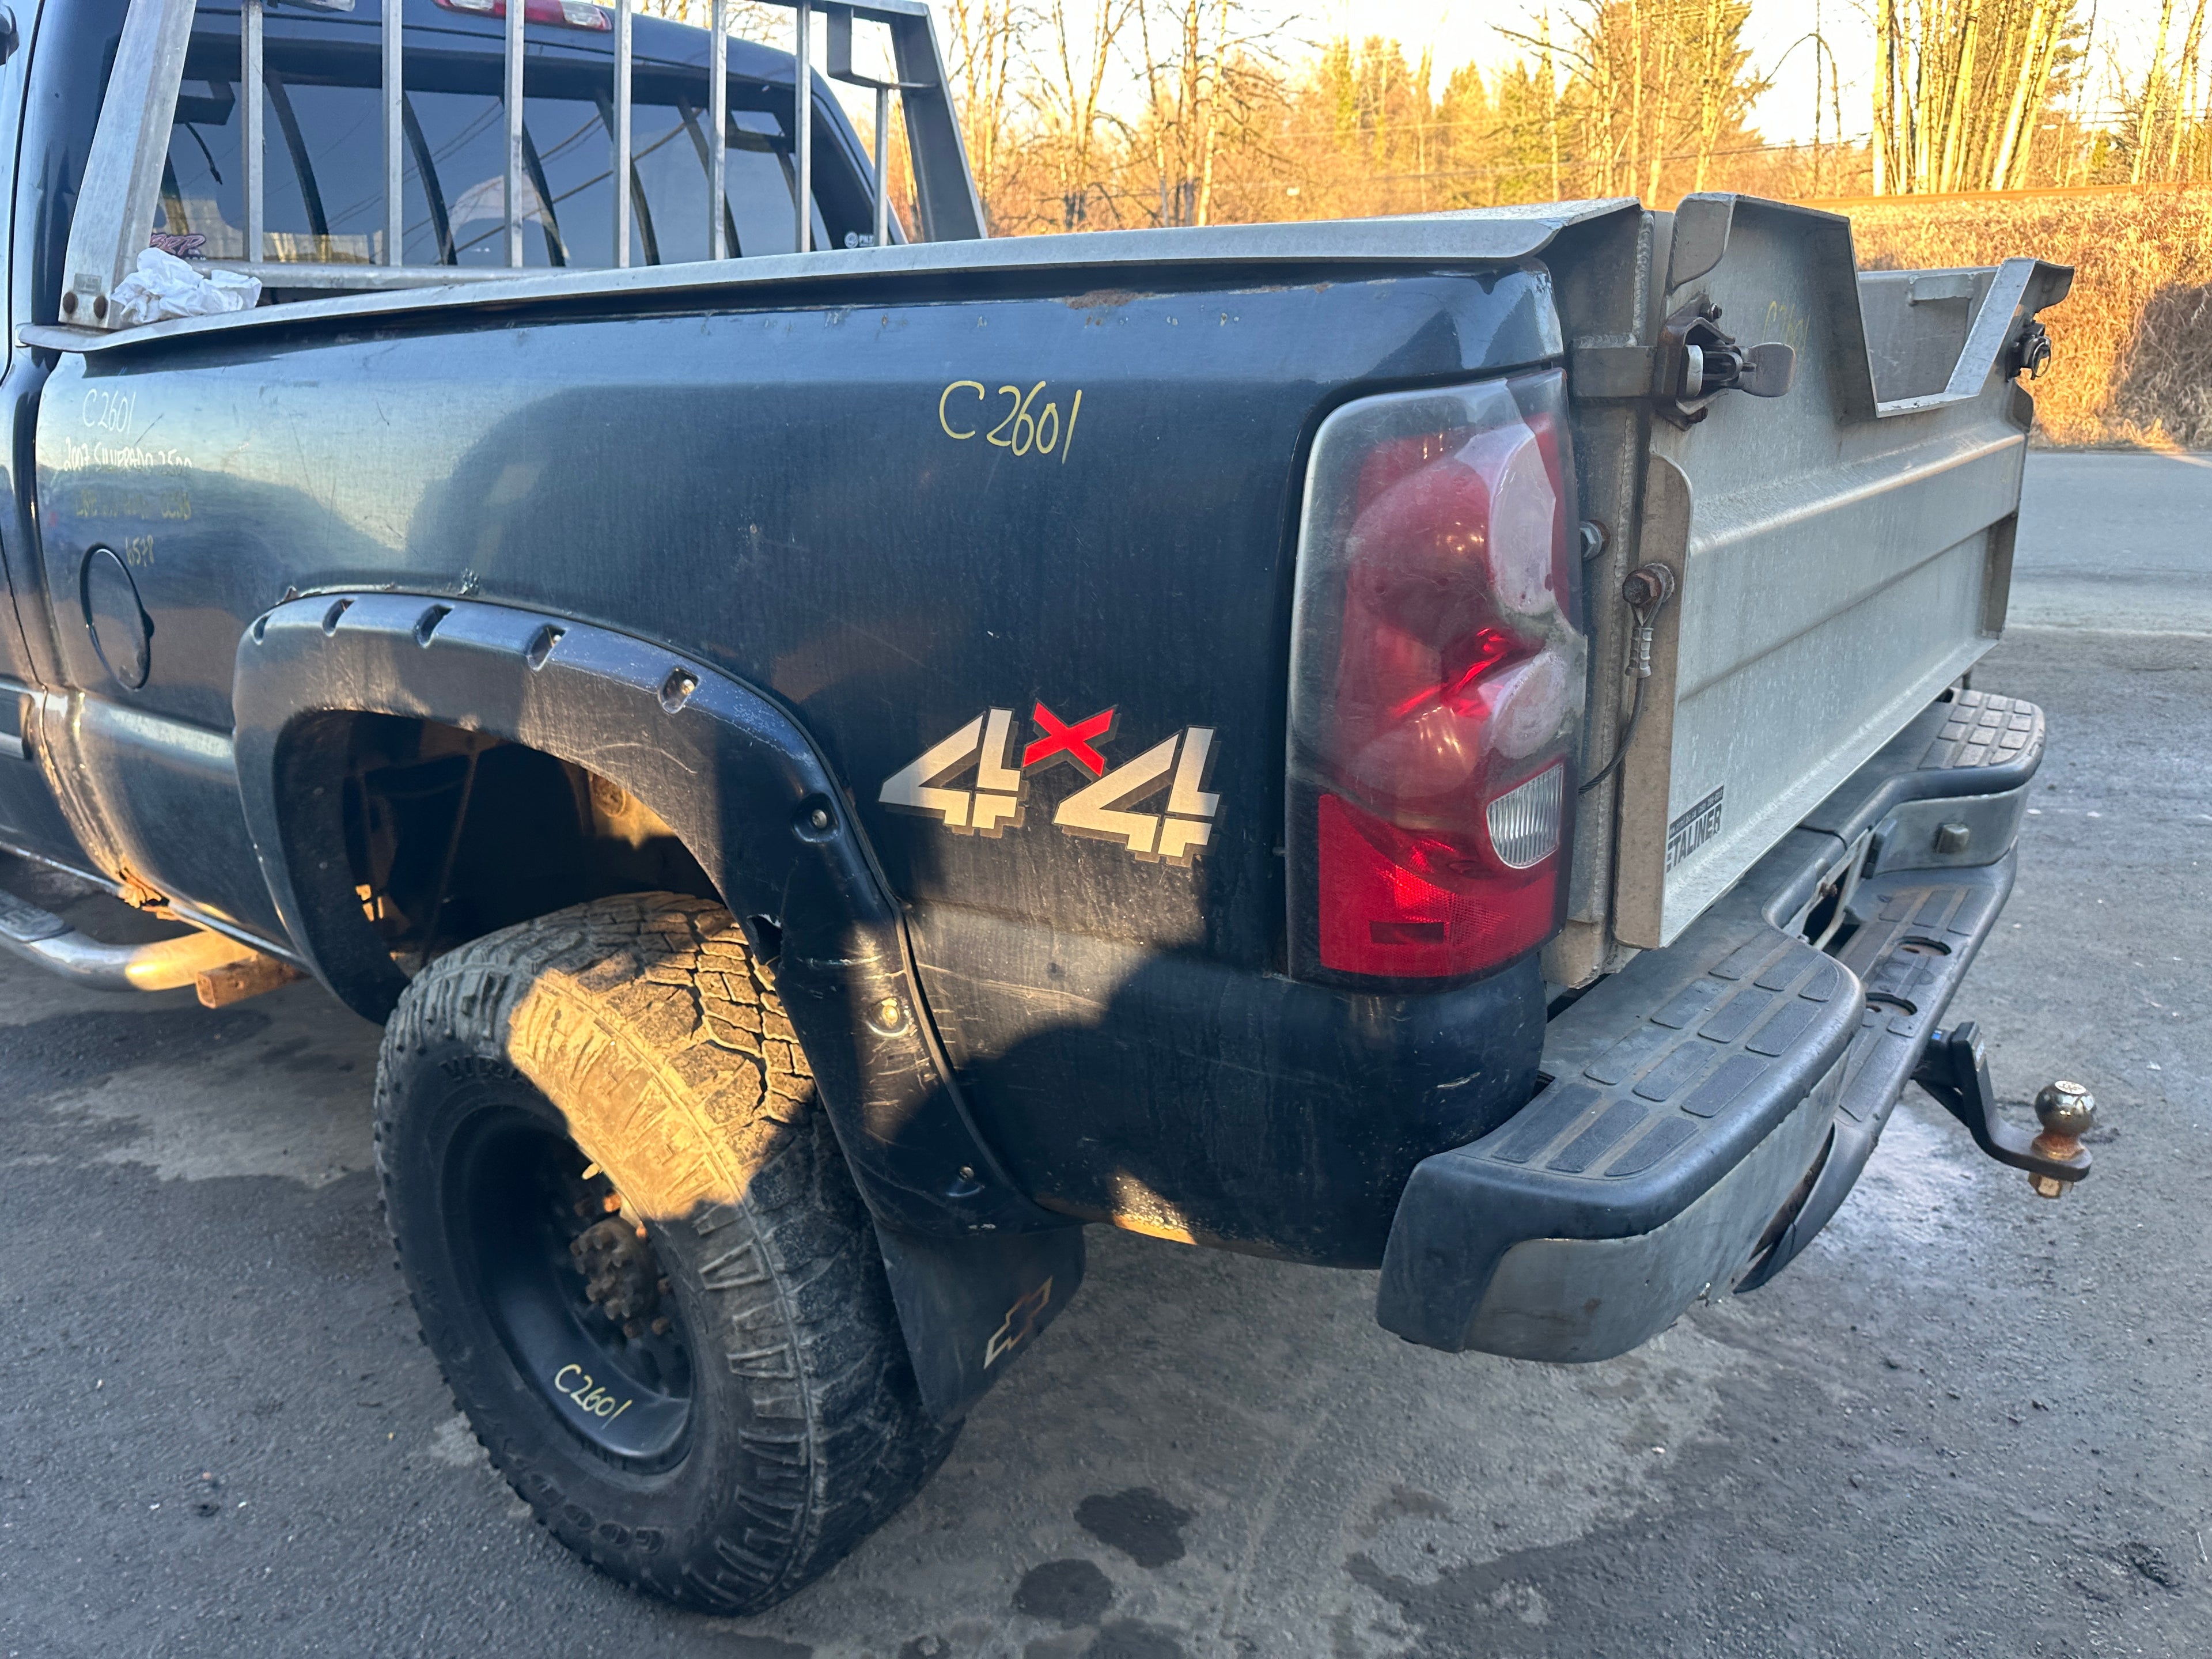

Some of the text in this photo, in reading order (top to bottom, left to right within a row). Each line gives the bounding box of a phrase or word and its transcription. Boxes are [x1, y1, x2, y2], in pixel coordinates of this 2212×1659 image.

[82, 388, 136, 434] C2601
[939, 380, 1082, 464] C2601
[554, 1363, 632, 1430] C2601
